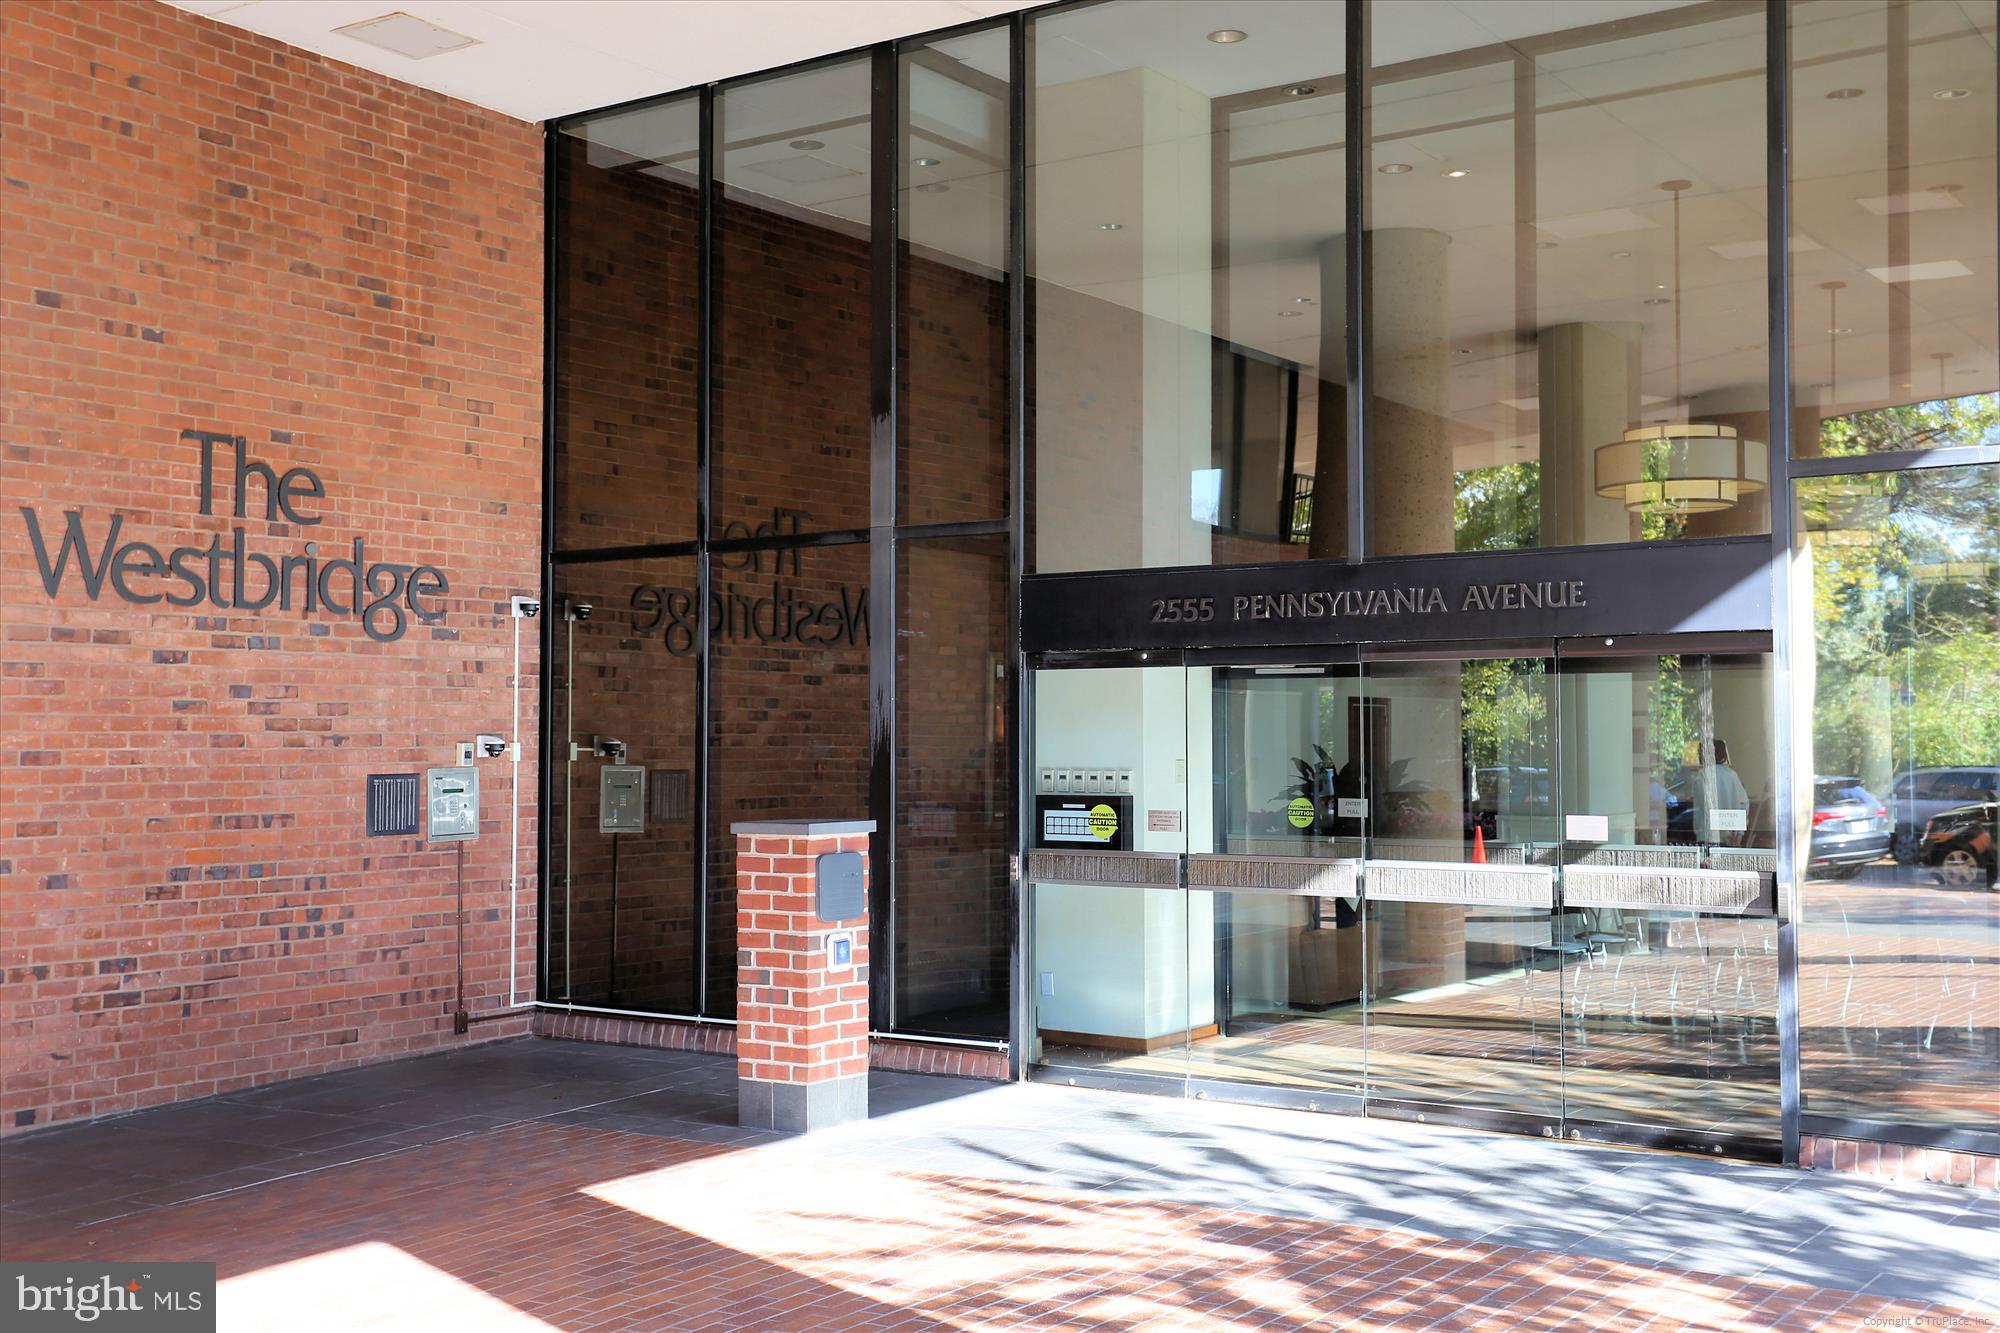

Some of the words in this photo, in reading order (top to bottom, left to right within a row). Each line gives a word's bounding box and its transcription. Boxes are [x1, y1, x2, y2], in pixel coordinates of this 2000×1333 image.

[181, 428, 325, 526] The
[19, 506, 450, 643] Westbridge
[1151, 597, 1215, 623] 2555
[1233, 586, 1448, 622] PENNSYLVANIA
[1460, 580, 1587, 612] AVENUE
